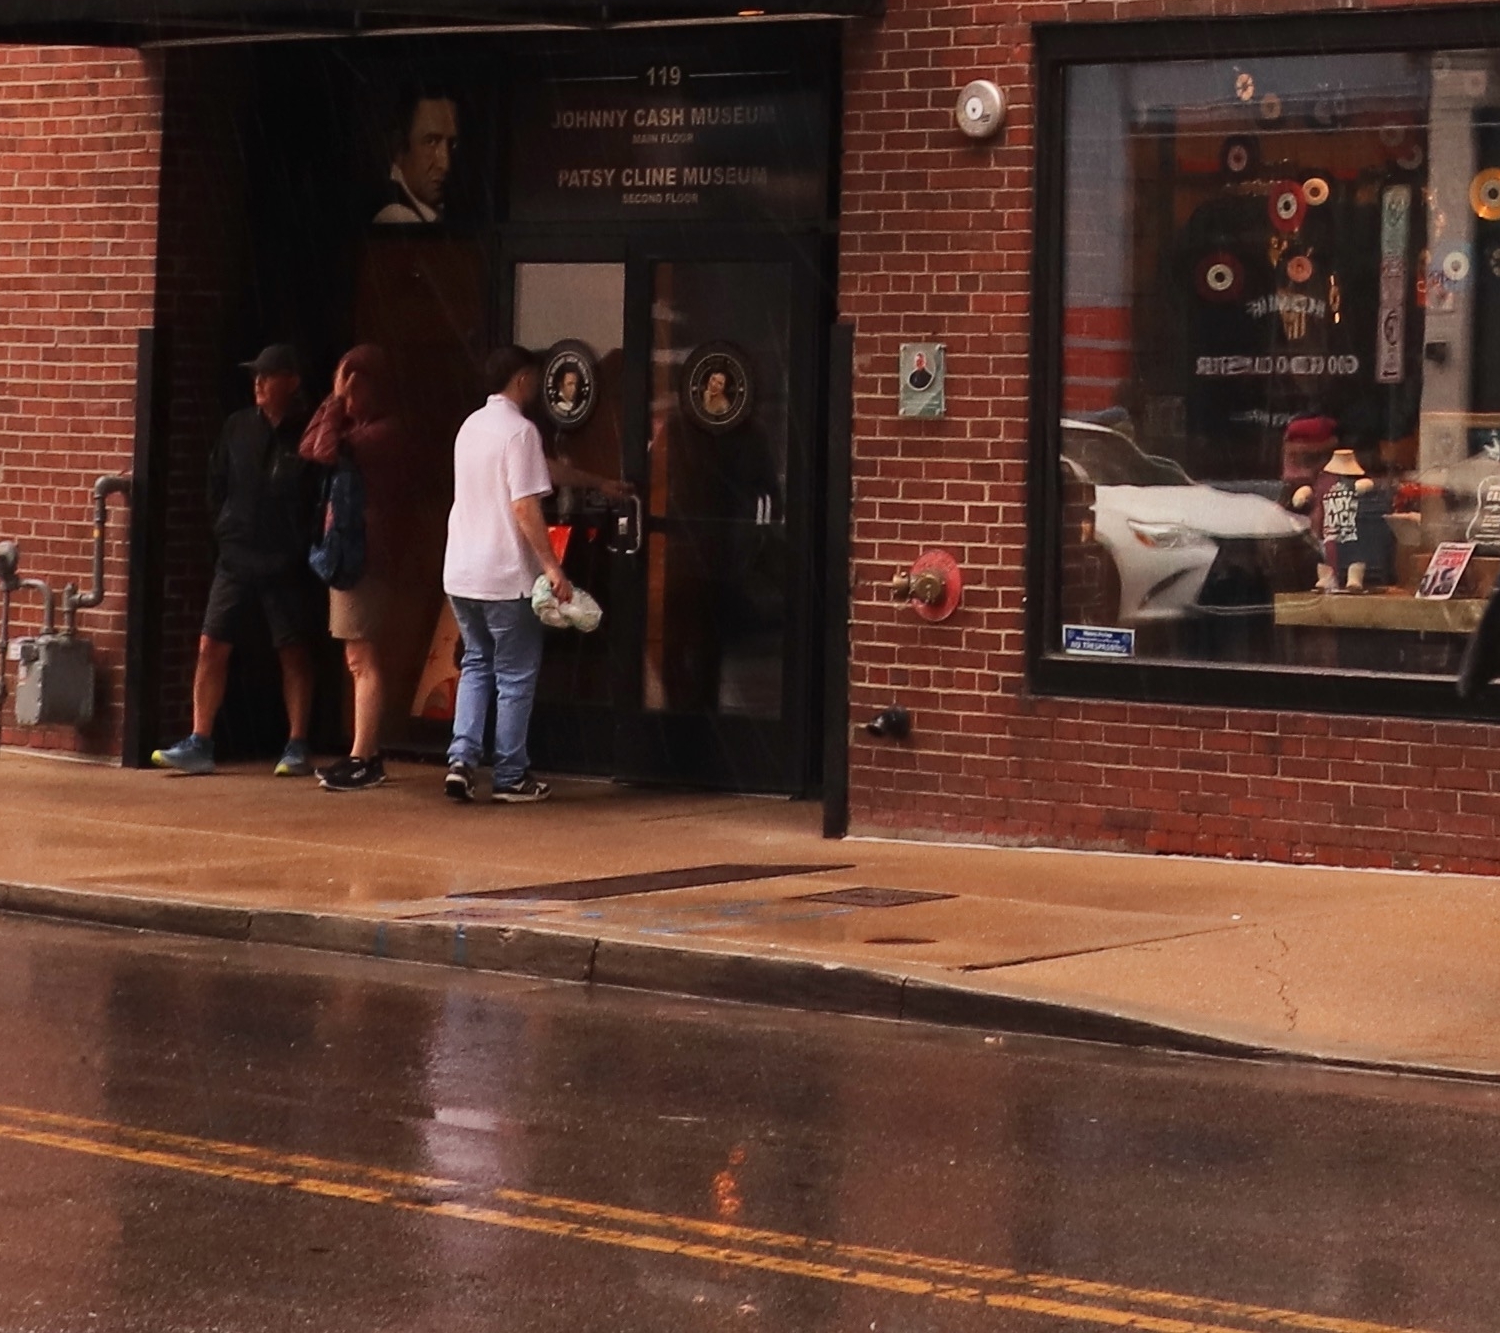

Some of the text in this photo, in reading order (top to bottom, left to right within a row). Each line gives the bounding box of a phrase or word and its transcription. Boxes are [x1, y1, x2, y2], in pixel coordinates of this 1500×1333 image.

[646, 65, 682, 86] 119
[551, 104, 777, 129] JOHNNY CASH MUSEUM
[631, 132, 695, 145] MAIN FLOOR
[557, 166, 768, 187] PATSY CLINE MUSEUM
[621, 192, 699, 205] SECOND FLOOR
